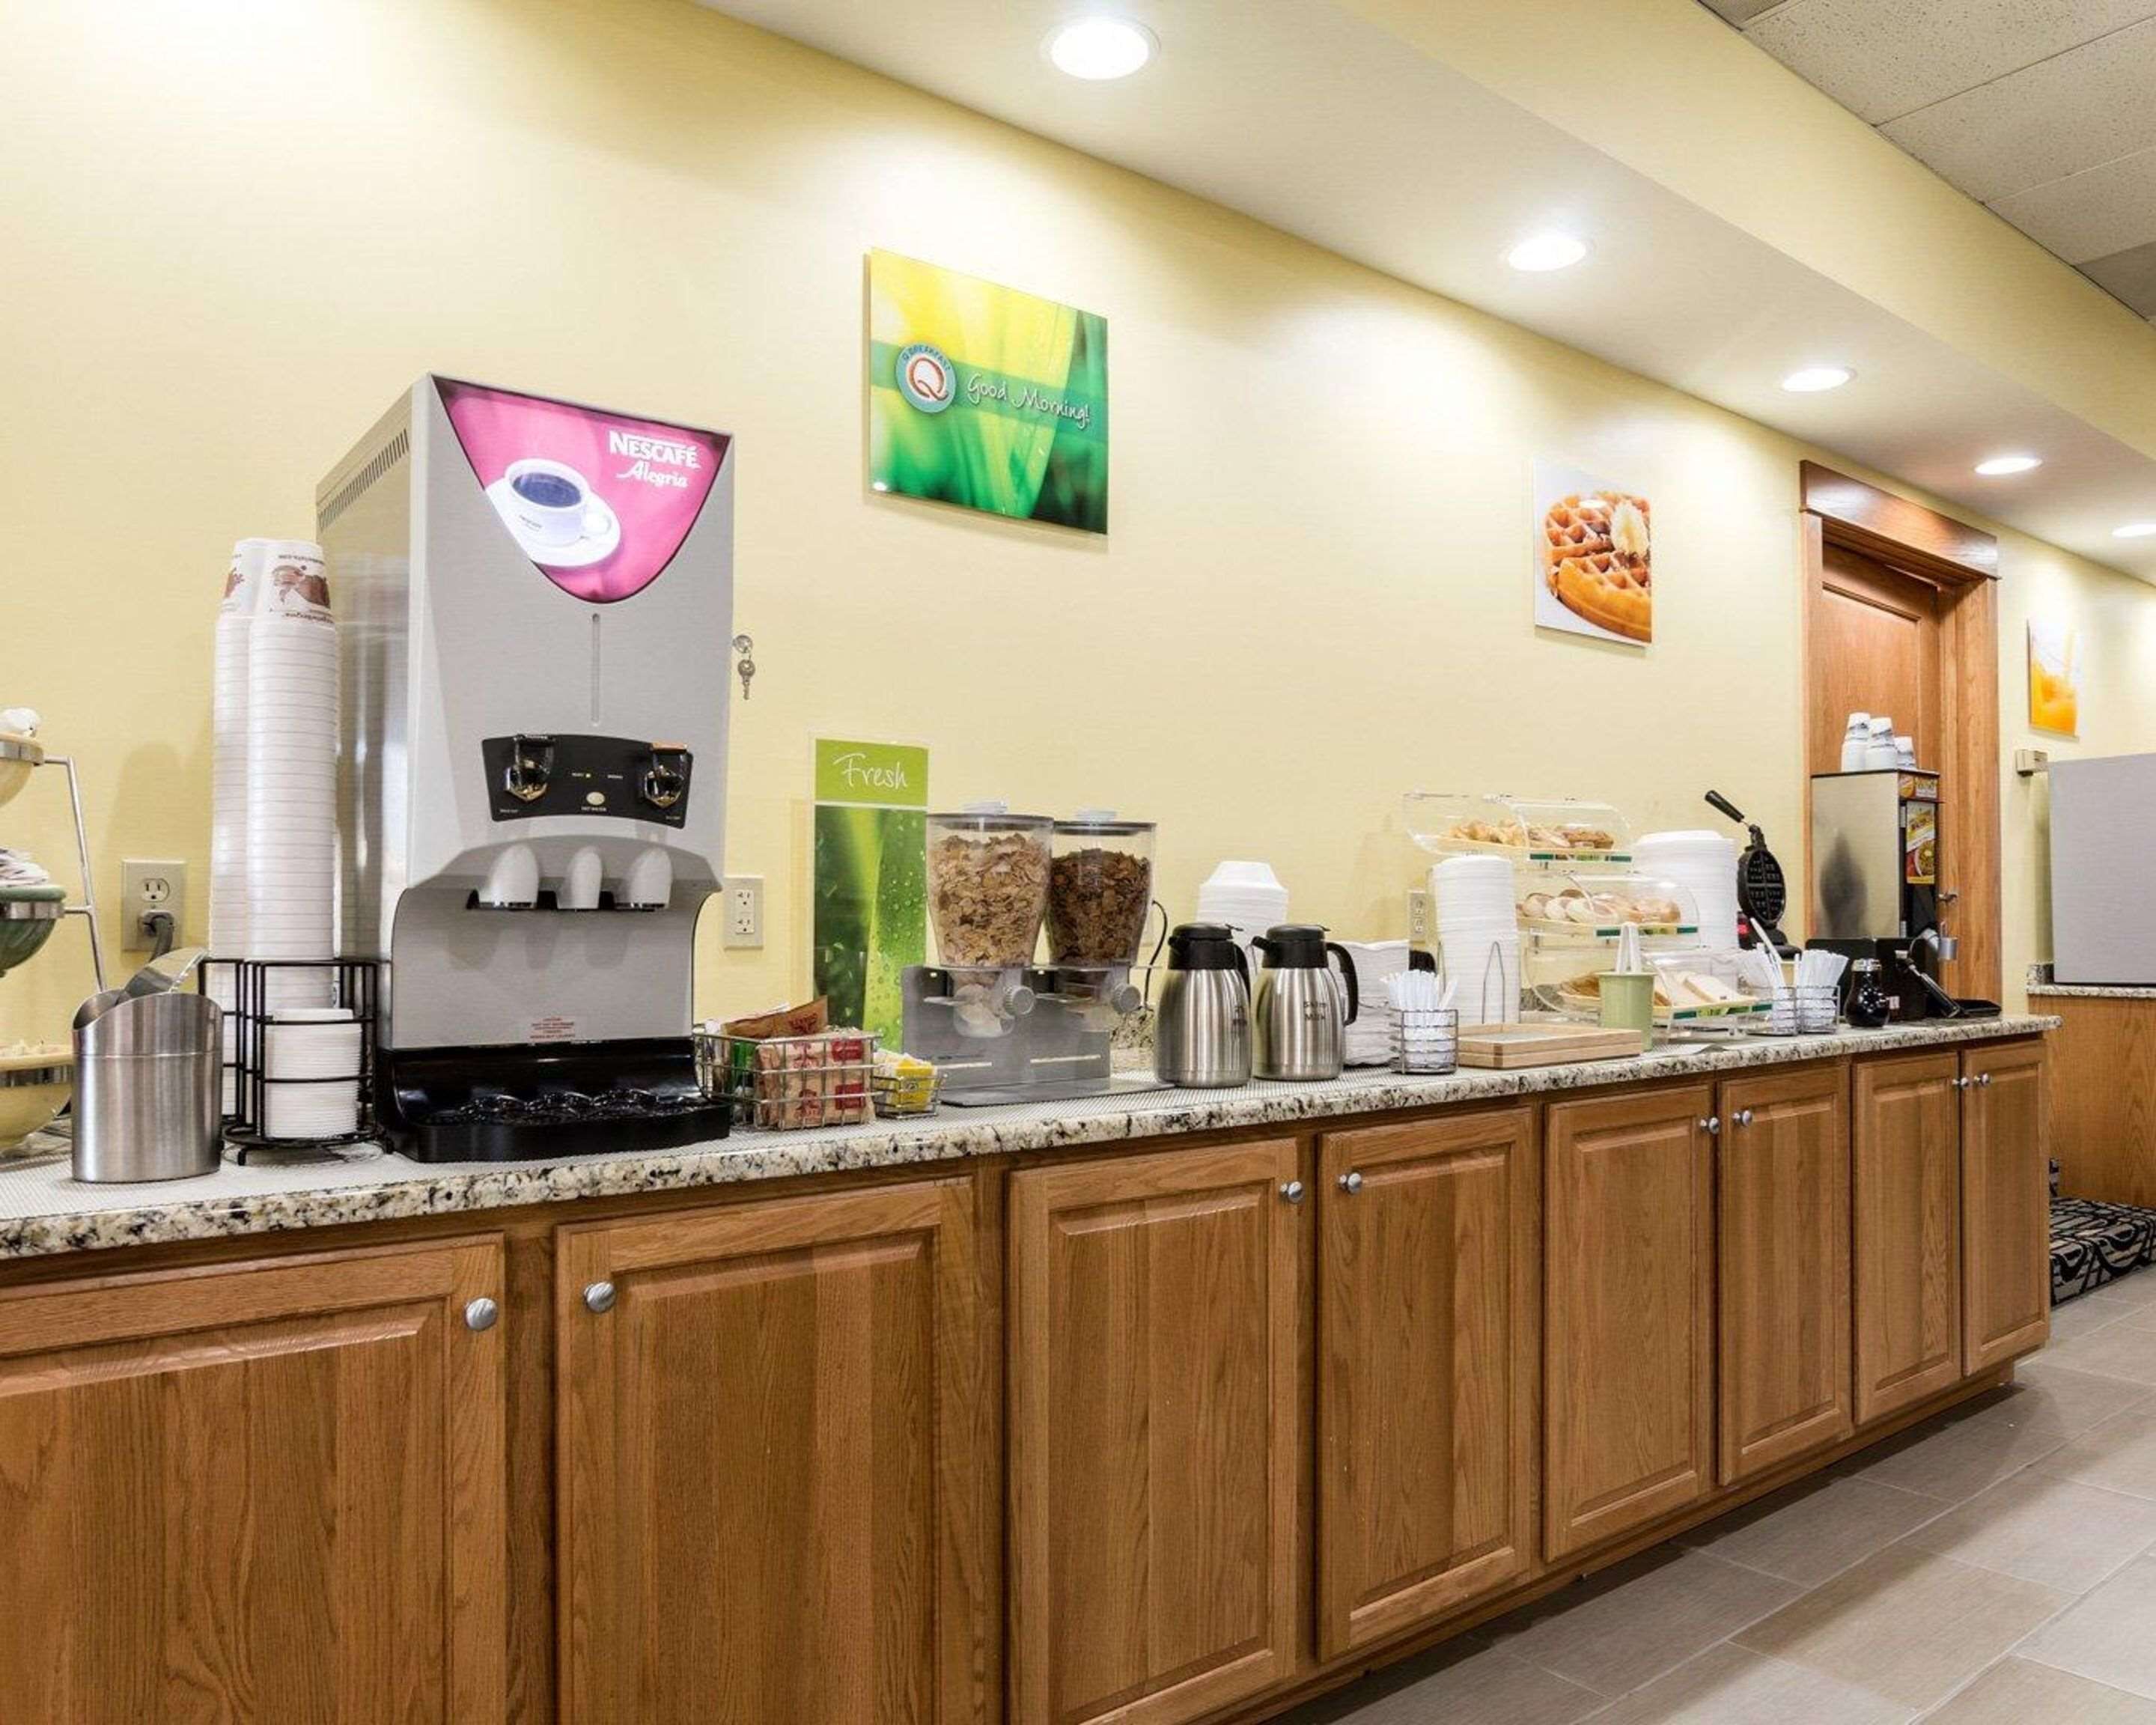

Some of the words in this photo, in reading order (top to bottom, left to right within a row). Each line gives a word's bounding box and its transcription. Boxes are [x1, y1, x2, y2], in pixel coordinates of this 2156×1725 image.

[908, 356, 949, 401] Q
[967, 373, 1008, 405] Good
[1011, 386, 1091, 430] Morning!
[609, 430, 700, 469] NESCAFÉ
[615, 460, 689, 489] Alegria
[832, 752, 909, 791] Fresh
